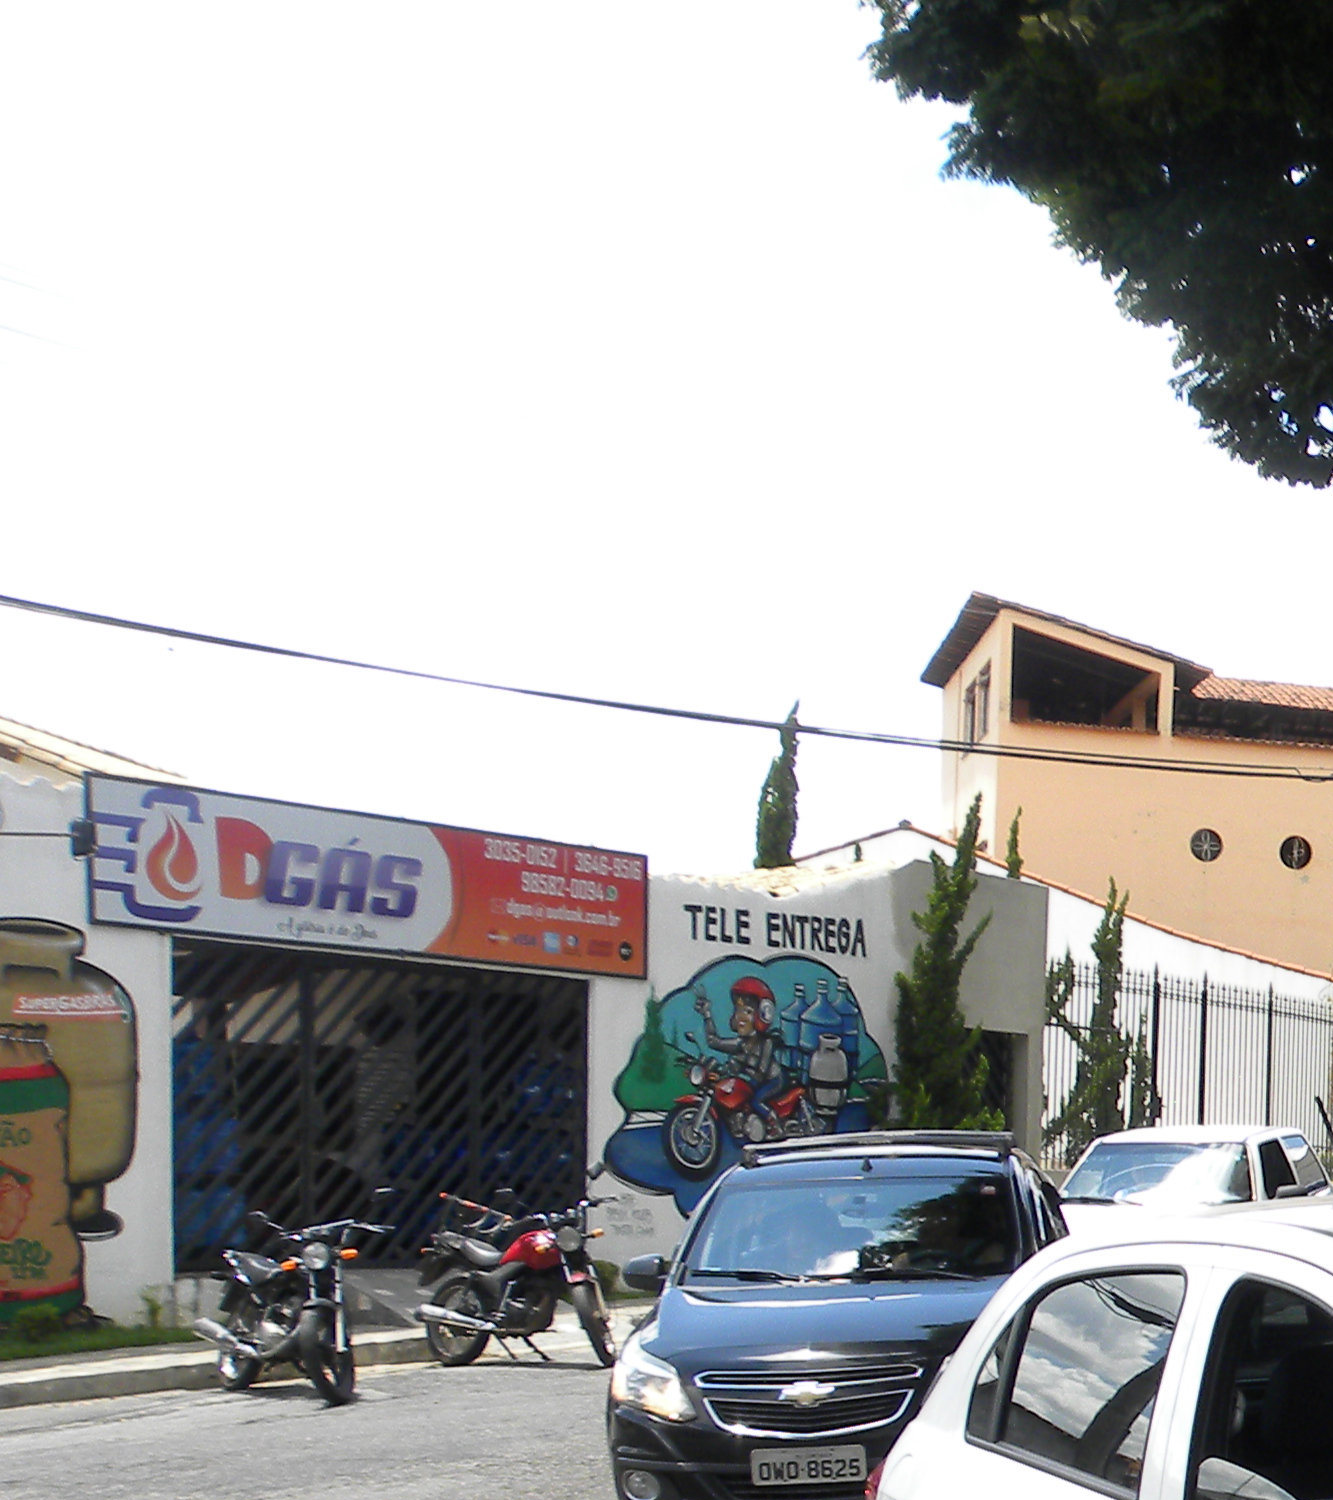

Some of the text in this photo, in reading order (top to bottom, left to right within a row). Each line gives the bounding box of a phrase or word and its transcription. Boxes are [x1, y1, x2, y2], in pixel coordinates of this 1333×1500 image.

[215, 817, 423, 919] DGÁS
[683, 904, 867, 957] TELE ENTREGA
[0, 1121, 33, 1147] ÃO
